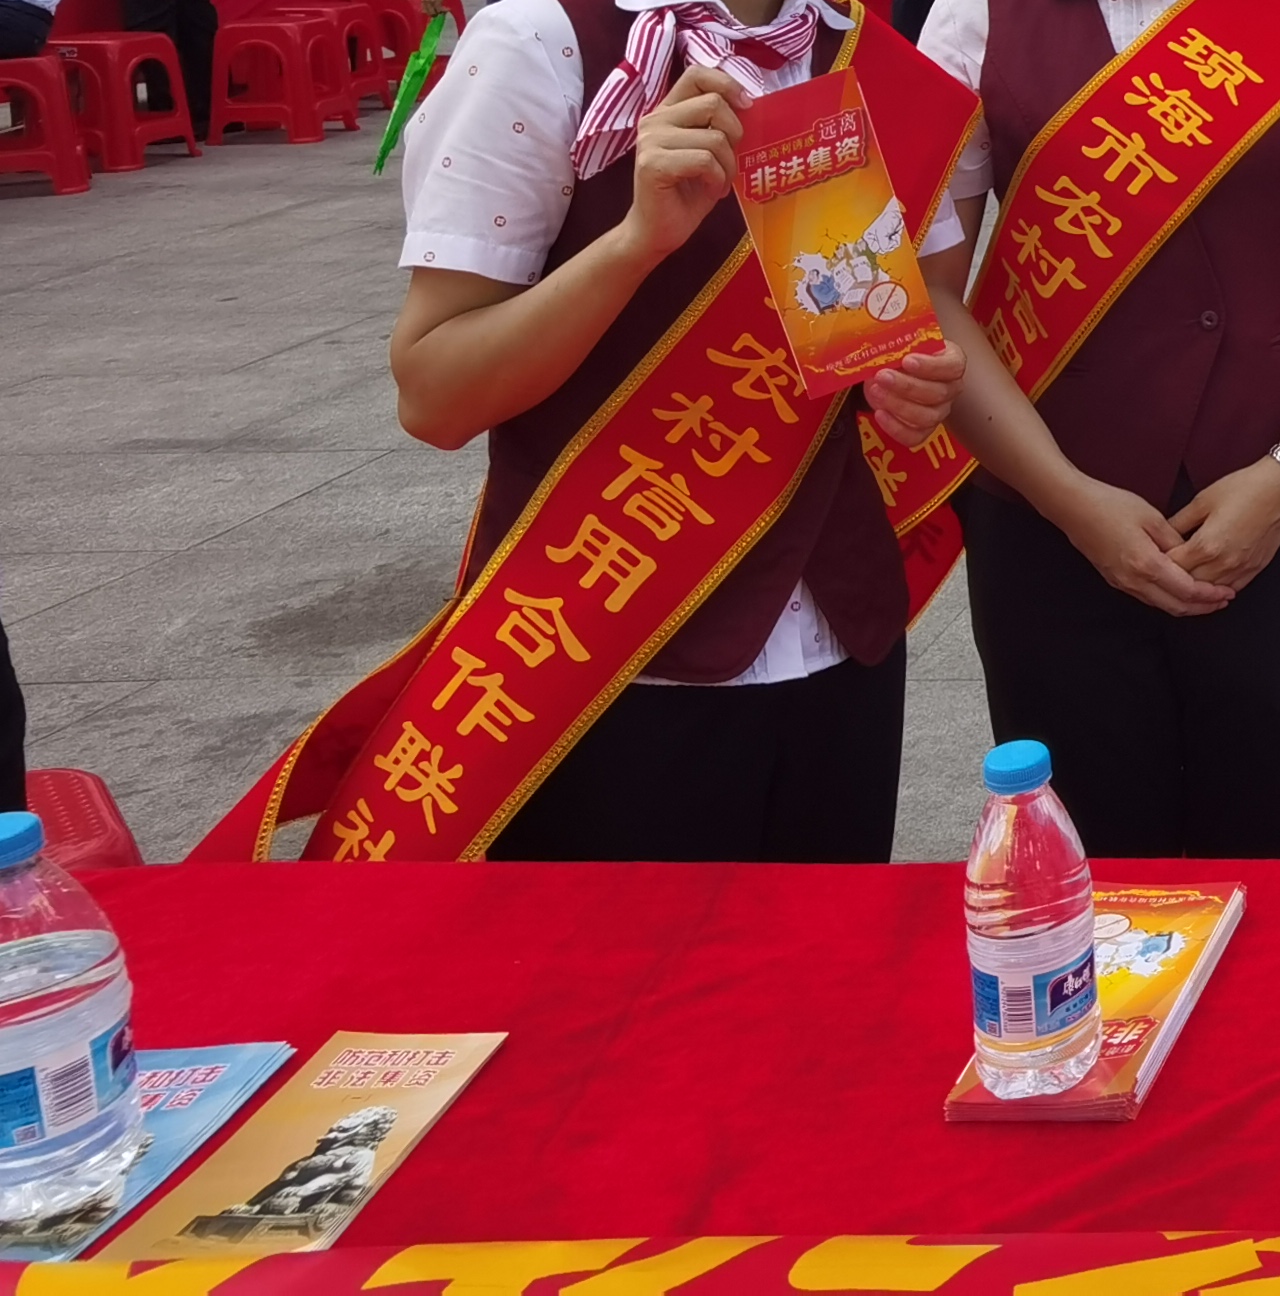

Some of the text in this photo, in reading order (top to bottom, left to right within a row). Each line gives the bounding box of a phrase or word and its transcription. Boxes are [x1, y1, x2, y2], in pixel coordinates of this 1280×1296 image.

[817, 112, 857, 141] 远离
[750, 135, 861, 196] 非法集资
[333, 296, 806, 862] 农村信用合作联社
[331, 1049, 457, 1067] 防范和打击
[310, 1069, 440, 1089] 非法集资
